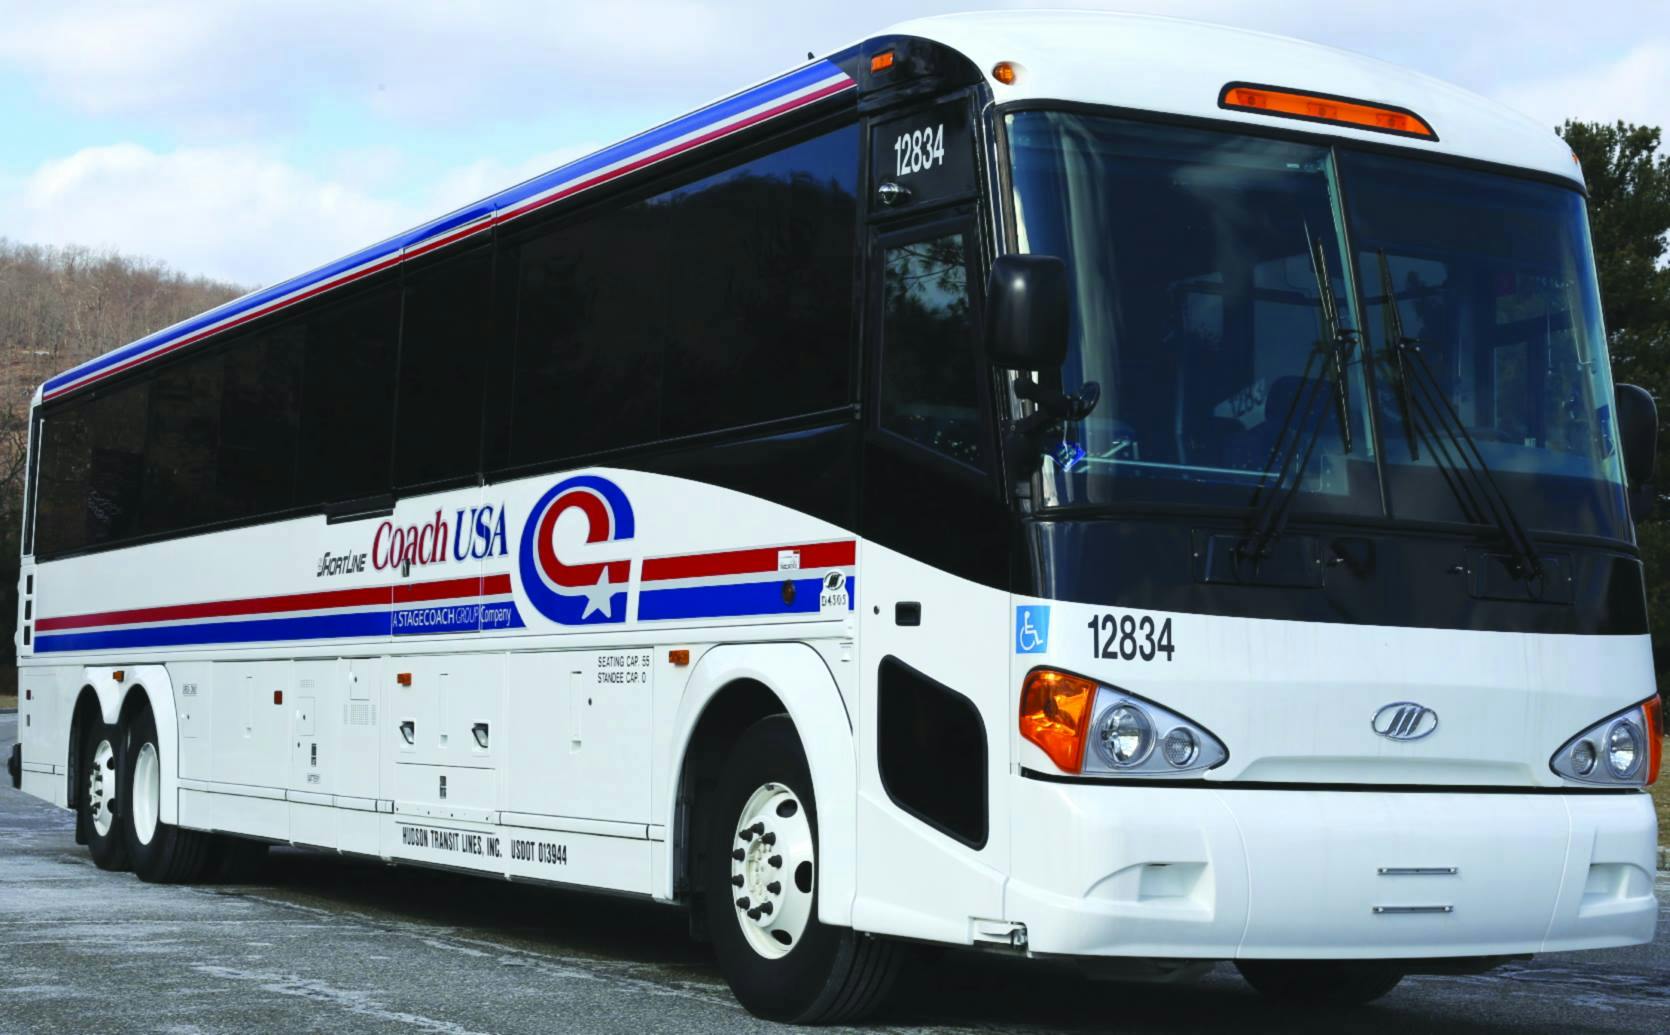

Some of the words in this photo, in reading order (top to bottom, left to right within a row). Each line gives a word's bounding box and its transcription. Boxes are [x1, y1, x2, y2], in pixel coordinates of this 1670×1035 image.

[894, 123, 945, 176] 12834
[372, 508, 448, 570] Coach
[453, 501, 508, 561] USA
[392, 612, 397, 627] A
[398, 608, 455, 627] STAGECOACH
[455, 606, 479, 624] GROUP
[480, 606, 512, 626] Company
[1087, 613, 1175, 662] 12834
[597, 655, 625, 668] SEATING
[626, 655, 640, 667] CAP.
[642, 655, 650, 667] 55
[597, 671, 624, 684] STANDEE
[626, 671, 640, 684] CAP.
[641, 671, 646, 684] 0
[402, 826, 428, 847] HUDSON
[430, 829, 459, 852] TRANSIT
[461, 833, 485, 857] LINES,
[486, 836, 503, 858] INC.
[511, 839, 535, 862] USDOT
[538, 842, 567, 866] 013944
